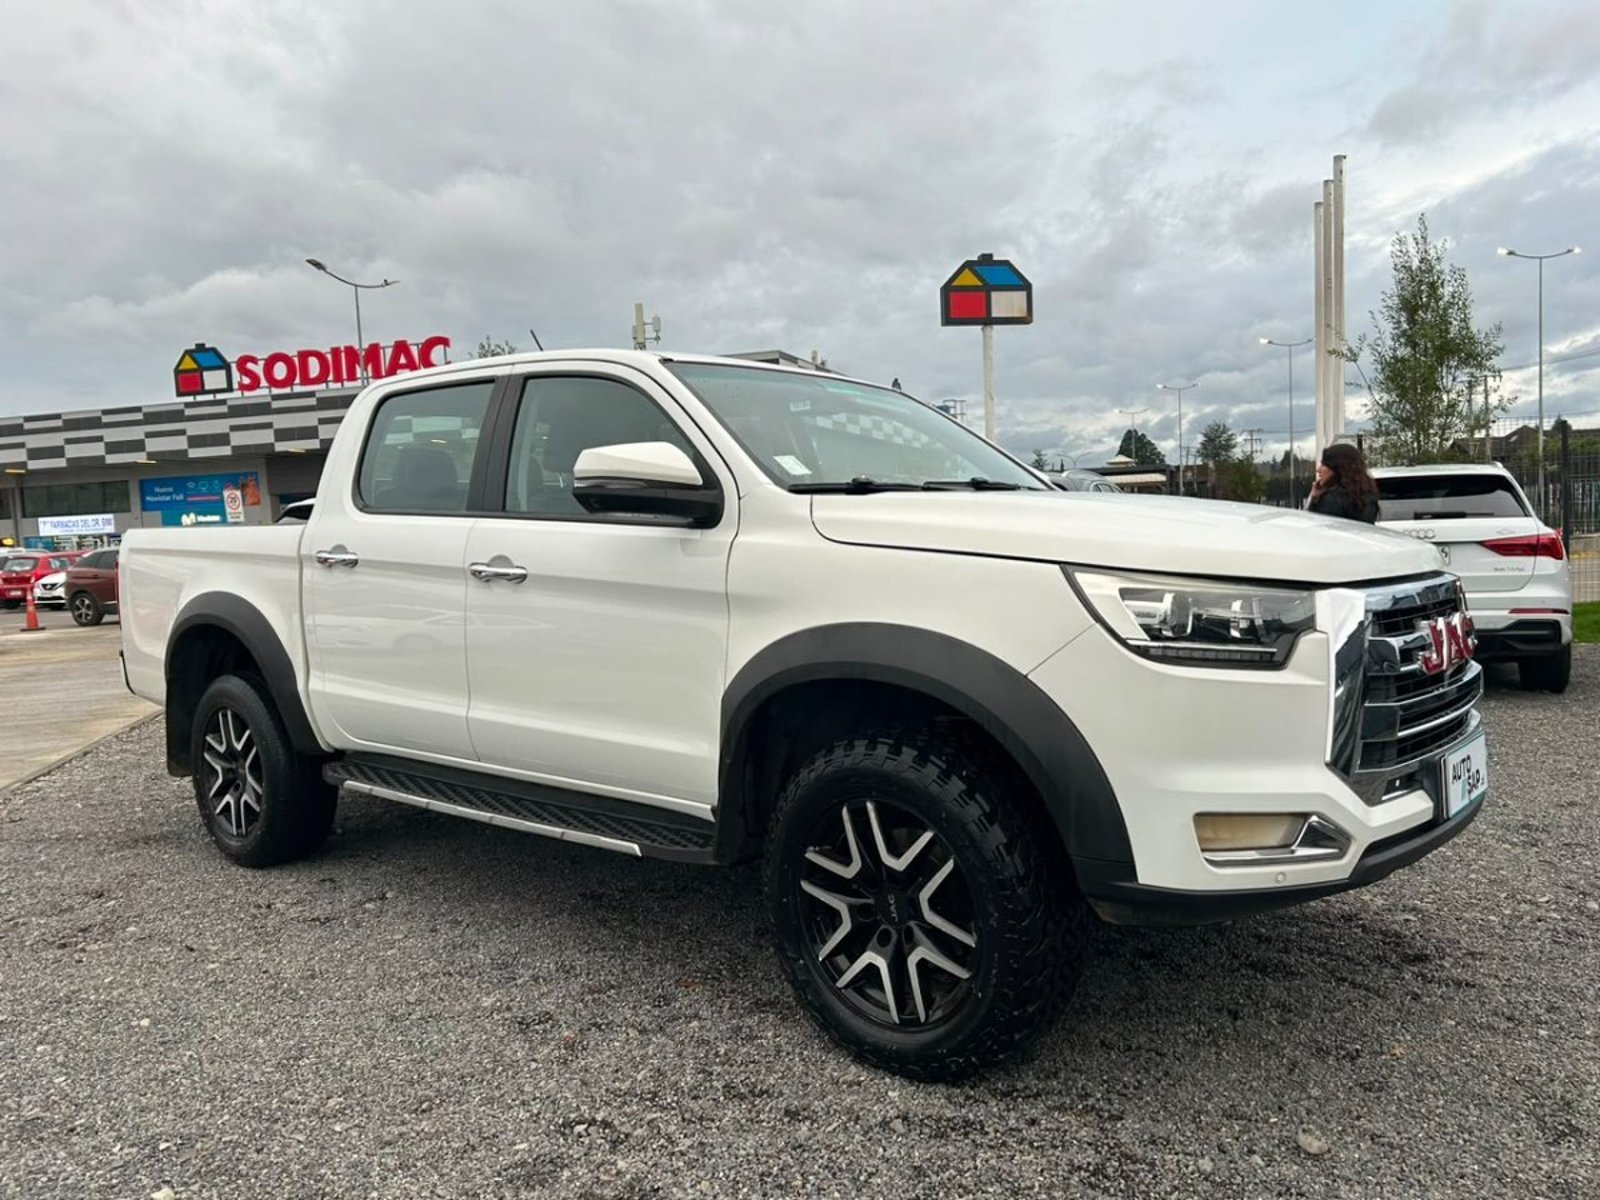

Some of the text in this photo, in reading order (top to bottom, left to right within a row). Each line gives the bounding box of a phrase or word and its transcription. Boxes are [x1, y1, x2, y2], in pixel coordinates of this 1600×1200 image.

[235, 336, 451, 392] SODIMAC
[1419, 609, 1475, 676] JAC
[1452, 754, 1472, 785] AUTO
